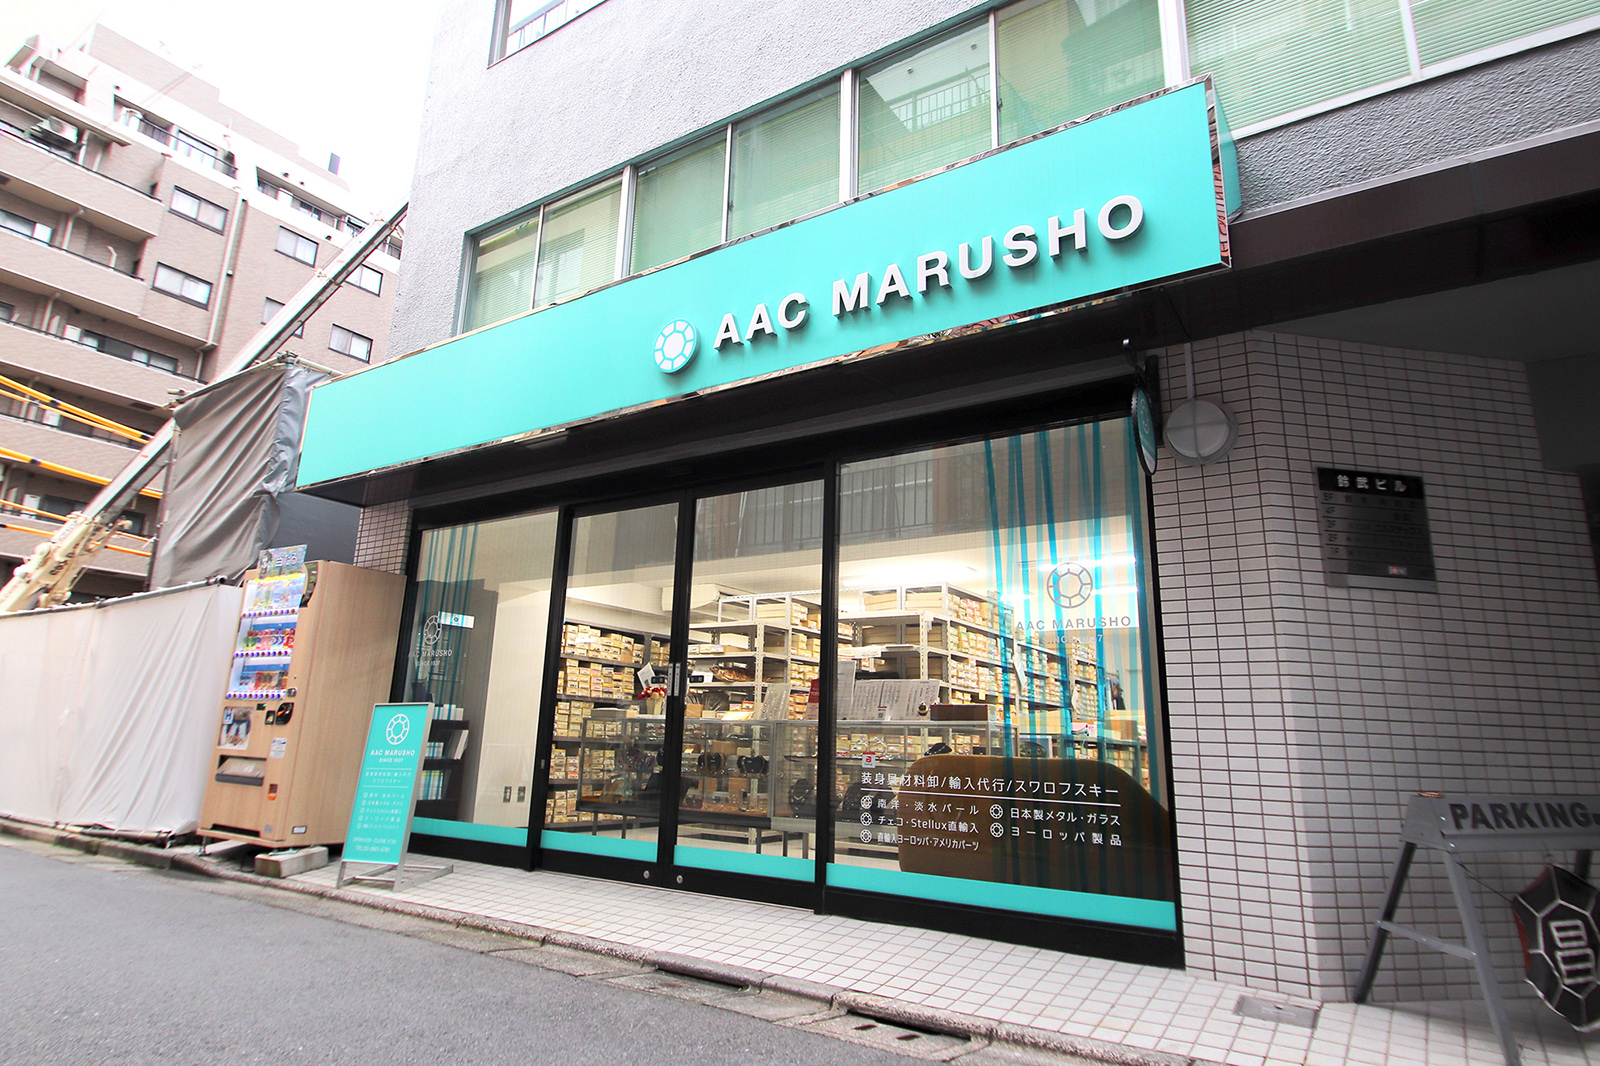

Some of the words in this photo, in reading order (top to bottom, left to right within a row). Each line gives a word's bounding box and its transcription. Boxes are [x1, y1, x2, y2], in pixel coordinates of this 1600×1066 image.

[713, 292, 810, 350] AAC
[832, 194, 1146, 318] MARUSHO
[1016, 620, 1045, 630] AAC
[1052, 616, 1131, 629] MARUSHO
[421, 649, 453, 658] MARUSHO
[1450, 802, 1592, 830] PARKING
